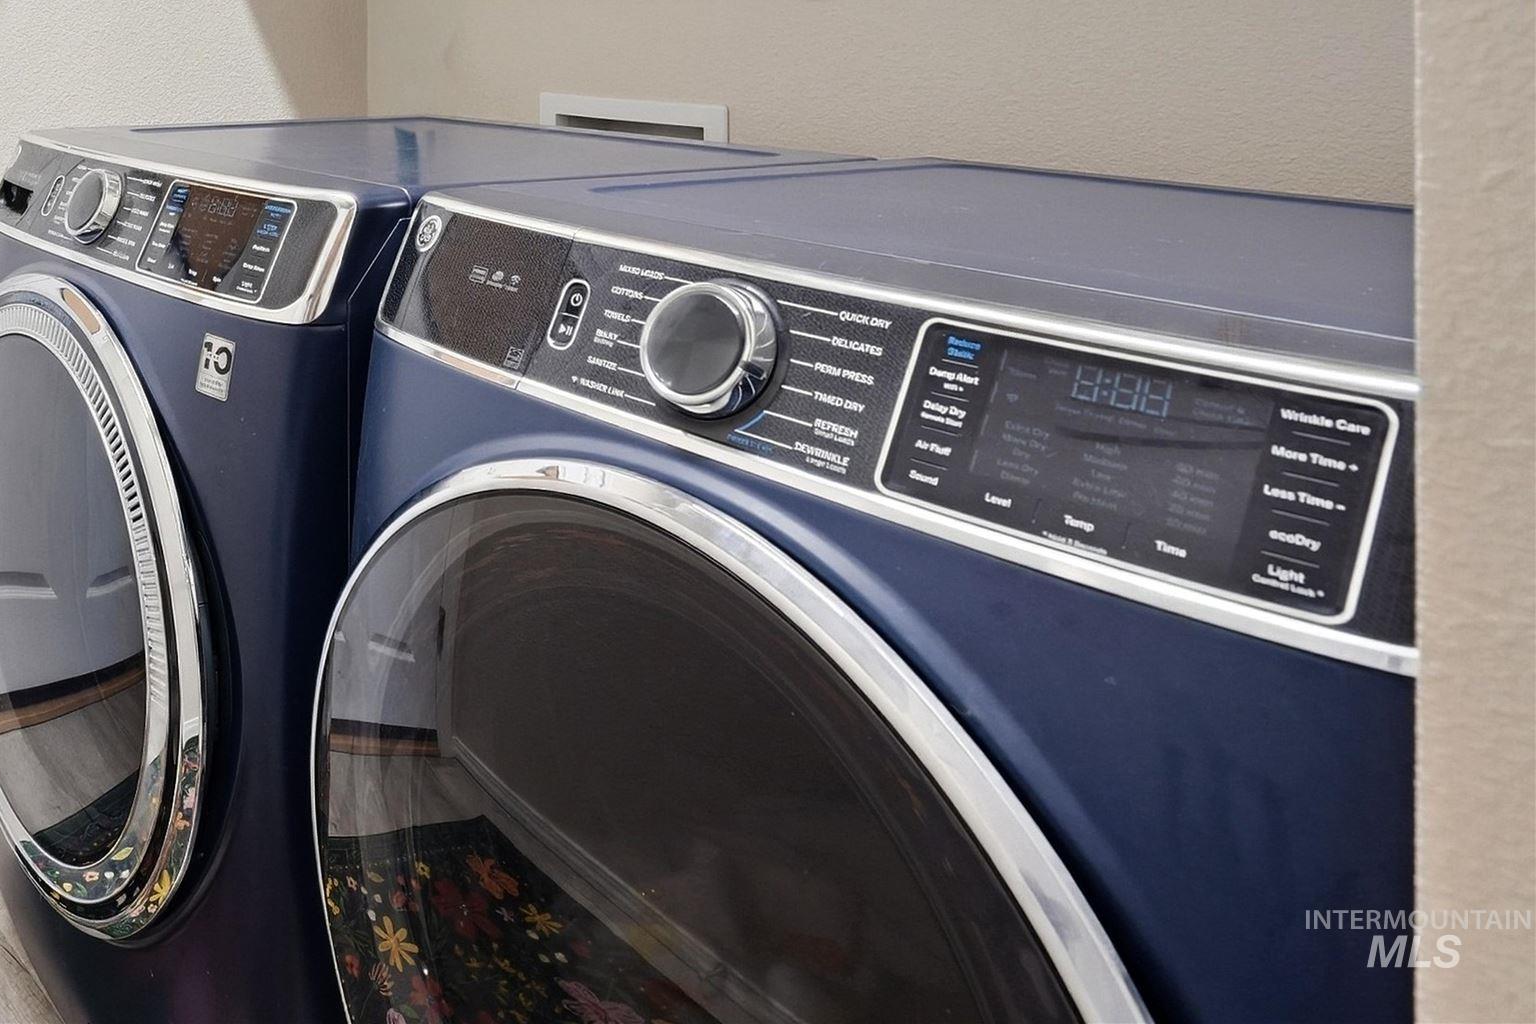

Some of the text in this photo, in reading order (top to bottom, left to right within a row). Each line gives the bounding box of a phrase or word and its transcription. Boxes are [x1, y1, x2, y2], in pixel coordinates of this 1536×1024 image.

[839, 310, 893, 329] QUICK DRY
[831, 336, 883, 357] DELICATES
[203, 341, 233, 376] 10
[814, 362, 875, 386] PERM PRESS
[928, 366, 981, 386] Damp Alert
[814, 390, 866, 414] TIMED DRY
[922, 399, 967, 419] Delay Dry
[814, 418, 859, 439] REFRESH
[1280, 408, 1372, 436] Wrinkle Care
[794, 442, 851, 467] DEWRINKLE
[915, 439, 930, 450] Air
[1271, 444, 1308, 463] More
[1309, 452, 1347, 472] Time
[908, 469, 940, 487] Sound
[984, 492, 1013, 509] Level
[1263, 483, 1296, 502] Less
[1296, 491, 1335, 511] Time
[1064, 514, 1095, 533] Temp
[1154, 539, 1188, 558] Time
[1268, 529, 1322, 552] ecoDry
[1267, 563, 1306, 585] Light
